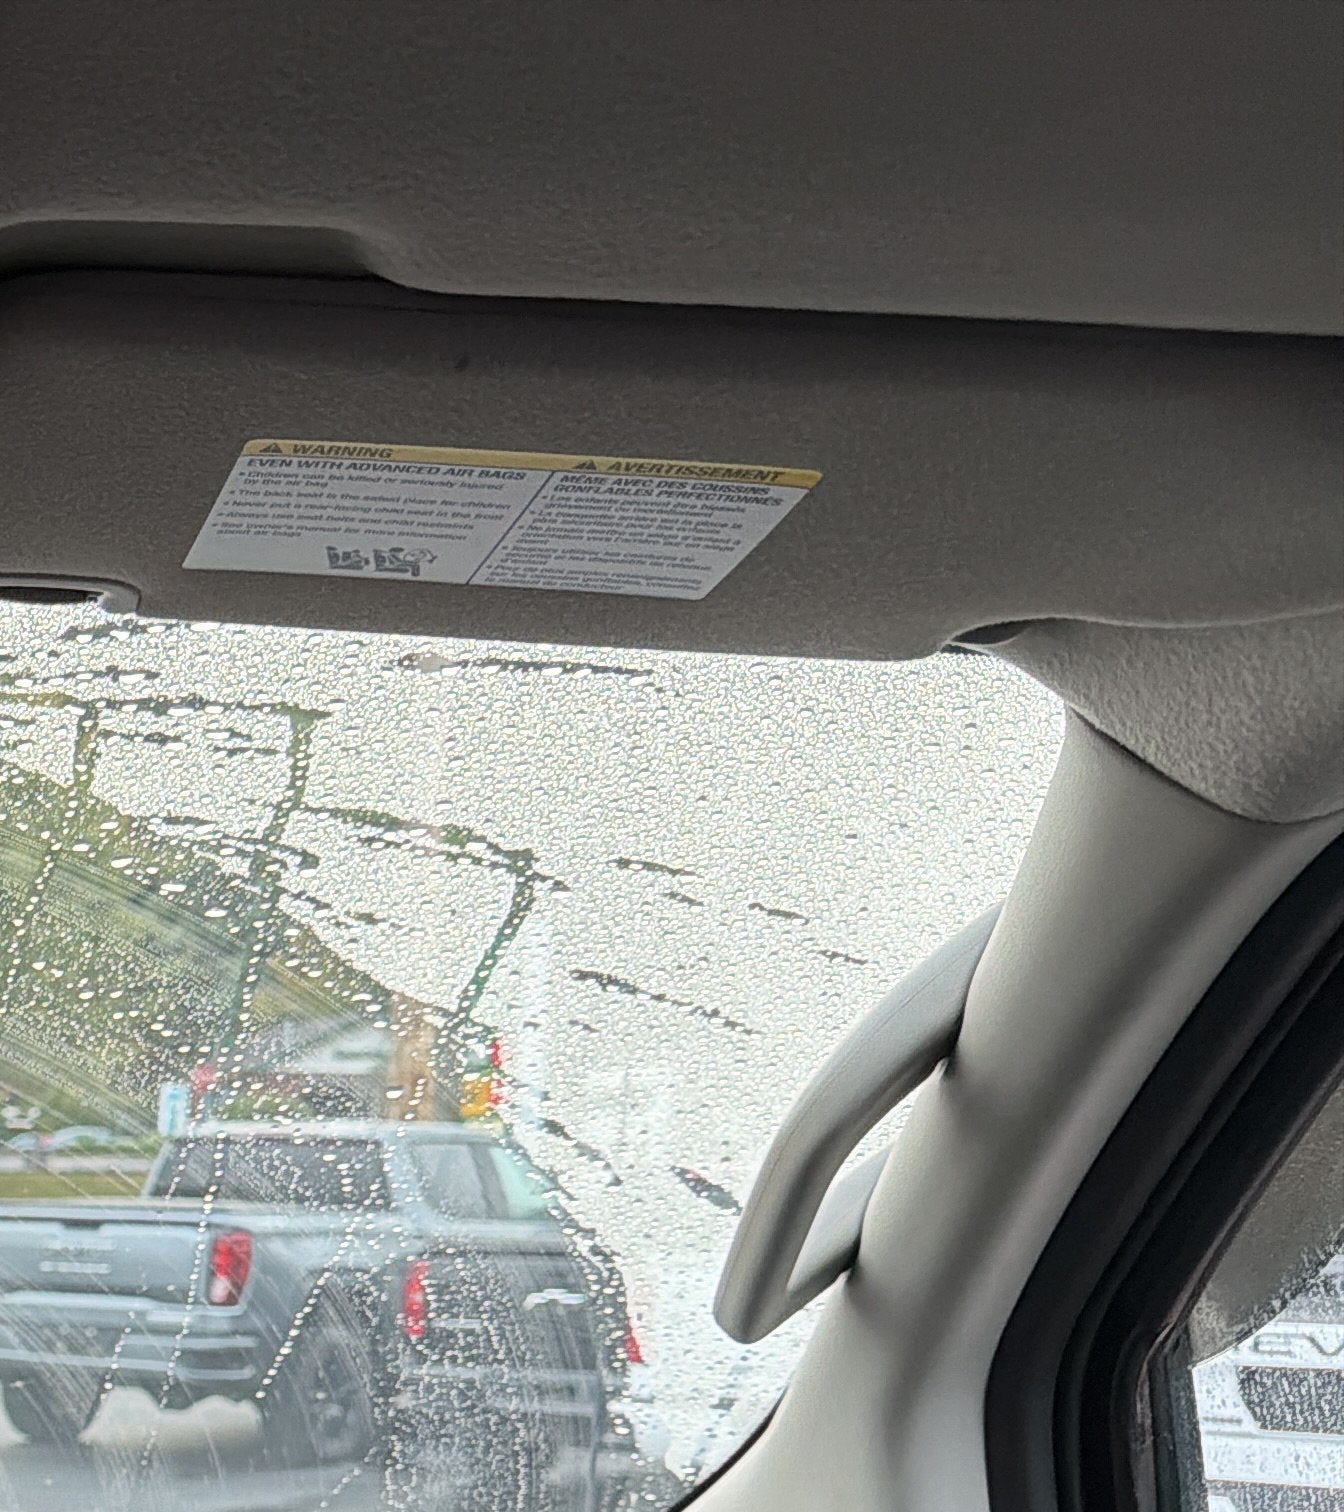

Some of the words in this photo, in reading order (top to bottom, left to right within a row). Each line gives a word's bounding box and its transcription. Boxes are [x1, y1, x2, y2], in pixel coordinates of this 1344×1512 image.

[292, 444, 394, 459] WARNING
[247, 459, 292, 467] EVEN
[298, 459, 343, 469] WITH
[345, 461, 441, 475] ADVANCED
[443, 468, 474, 478] AIR
[478, 470, 527, 480] BAGS
[607, 461, 786, 481] AVERTISSEMENT
[554, 484, 654, 496] GONFLABLES
[656, 490, 784, 506] PERFECTIONNÉS
[559, 474, 609, 485] MÊME
[611, 477, 654, 487] AVEC
[656, 480, 688, 489] DES
[692, 483, 771, 495] COUSSINS
